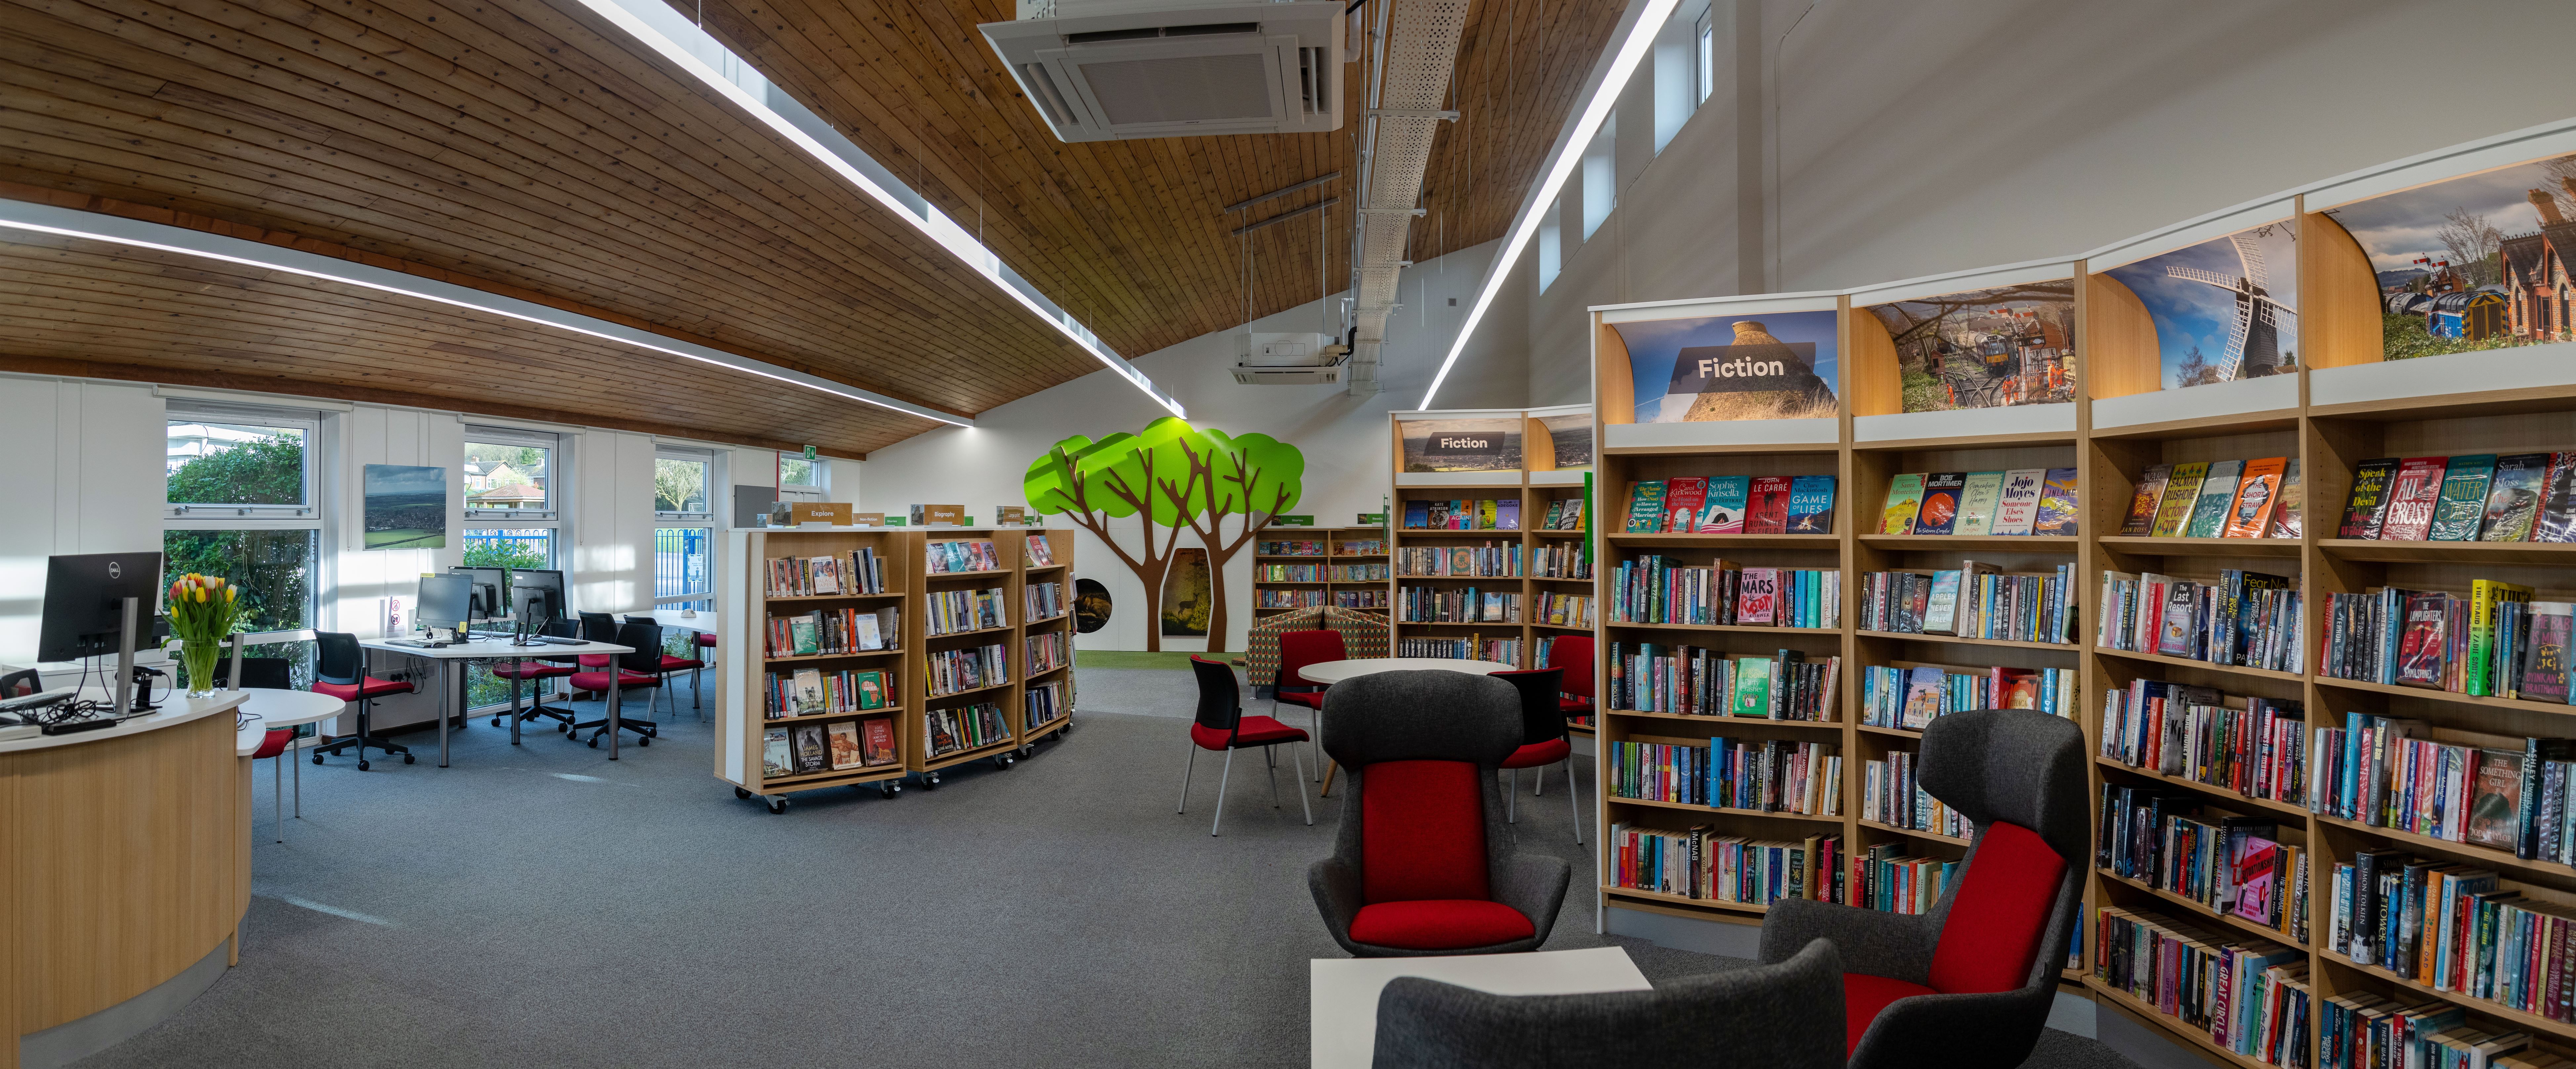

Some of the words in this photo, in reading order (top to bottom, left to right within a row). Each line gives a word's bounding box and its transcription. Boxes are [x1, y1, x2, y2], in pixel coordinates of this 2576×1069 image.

[1698, 356, 1784, 378] Fiction
[1441, 437, 1488, 448] Fiction
[2498, 460, 2524, 472] Sarah
[2144, 472, 2162, 481] WAR
[2358, 468, 2386, 480] Speak
[1709, 481, 1737, 491] Sophie
[1764, 482, 1788, 492] CARRÉ
[2011, 476, 2033, 489] Jojo
[2141, 482, 2158, 491] CRY
[2170, 476, 2199, 488] SALMAN
[2365, 482, 2382, 491] the
[2494, 477, 2519, 487] Moss
[1669, 488, 1702, 497] Kirkwood
[1708, 489, 1739, 497] Kinsella
[2004, 488, 2035, 500] Moyes
[2165, 488, 2196, 501] RUSHDIE
[2395, 478, 2418, 500] ALI
[2445, 481, 2482, 500] WATER
[1793, 495, 1827, 504] GAME
[2352, 496, 2377, 506] Devil
[1800, 505, 1822, 513] LIES
[2387, 502, 2431, 525] CROSS
[2161, 519, 2178, 532] CITY
[1741, 580, 1773, 594] MARS
[2173, 591, 2189, 602] Last
[2168, 601, 2192, 613] Resort
[2409, 610, 2442, 622] LAMPLIGHTERS
[1745, 679, 1760, 687] Party
[2494, 759, 2507, 767] THE
[2480, 766, 2521, 779] SOMETHING
[2489, 778, 2506, 788] GIRL
[2219, 966, 2228, 999] GREAT
[2215, 1000, 2226, 1035] CIRCLE
